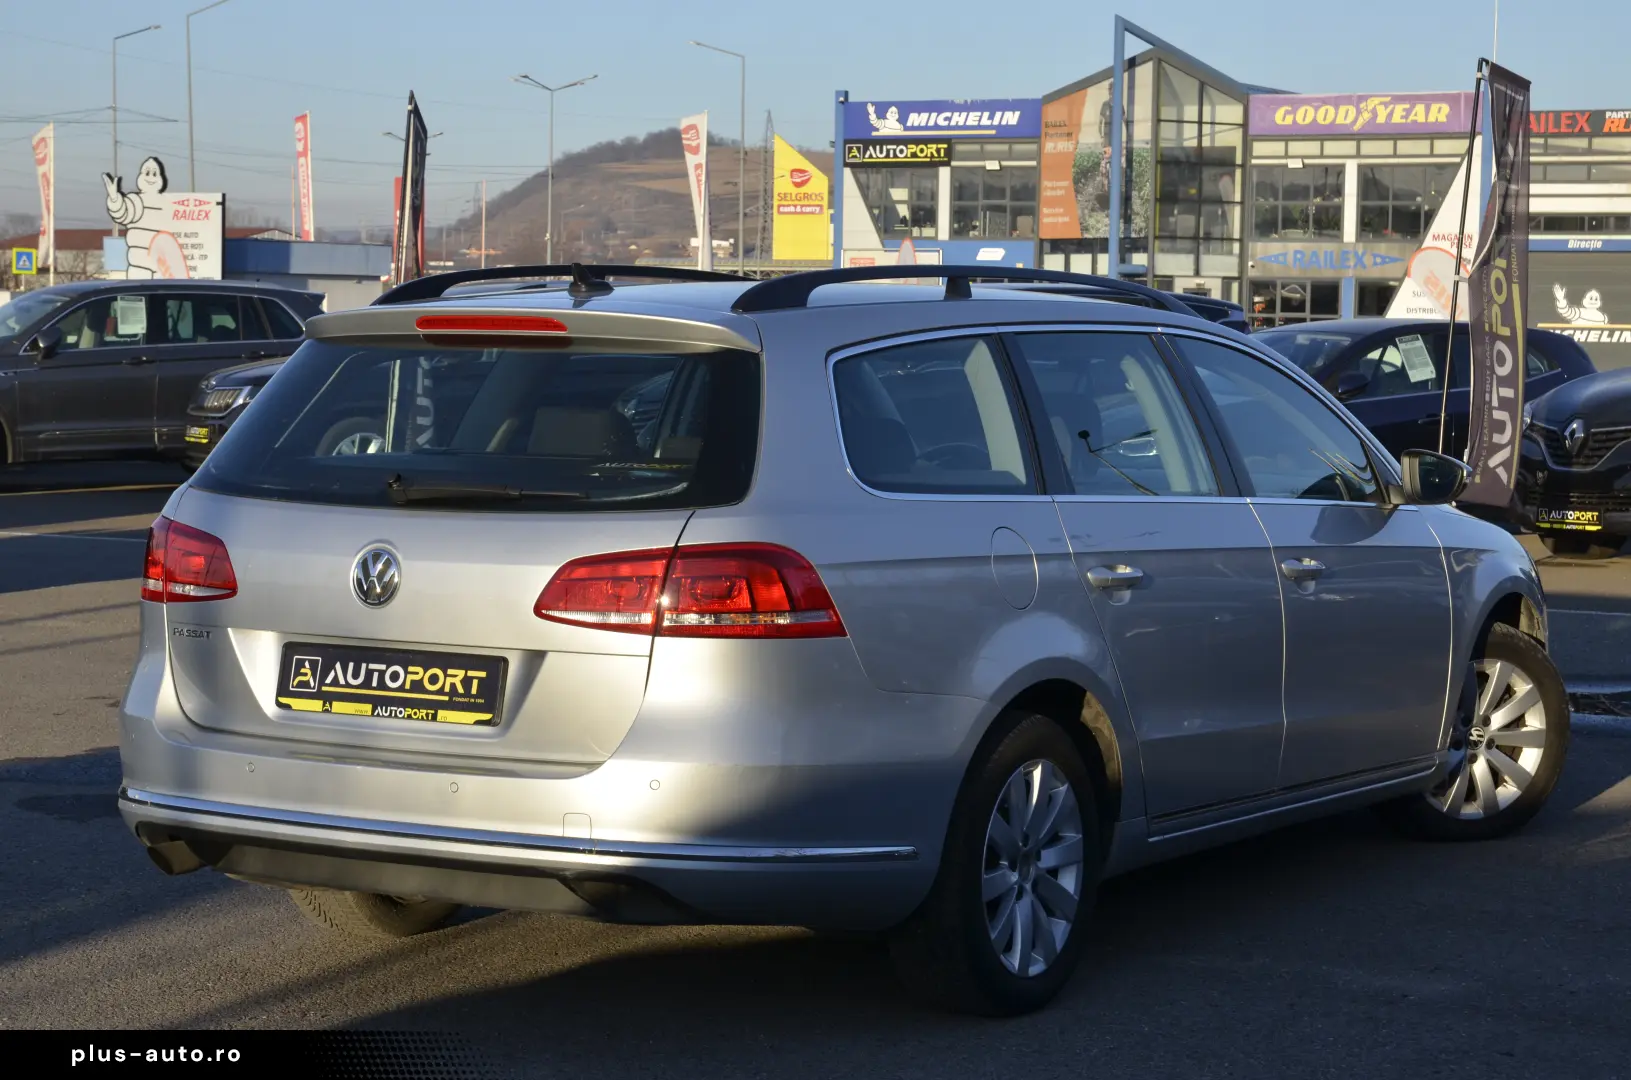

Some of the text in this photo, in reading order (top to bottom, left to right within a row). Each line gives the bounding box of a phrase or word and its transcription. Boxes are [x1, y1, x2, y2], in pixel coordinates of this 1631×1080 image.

[906, 111, 1021, 127] MICHELIN
[1605, 111, 1631, 119] PART
[1529, 111, 1592, 134] AILEX
[864, 144, 948, 159] AUTOPORT
[777, 192, 824, 201] SELGROS
[172, 209, 211, 221] RAILEX
[802, 206, 820, 214] carry
[1432, 233, 1473, 242] MAGAIN
[1450, 241, 1473, 249] PISE
[1292, 250, 1367, 270] RAILEX
[1550, 510, 1599, 521] AUTOPORT
[173, 627, 212, 640] PASSAT
[325, 661, 487, 695] AUTOPORT
[374, 706, 435, 720] AUTOPORT
